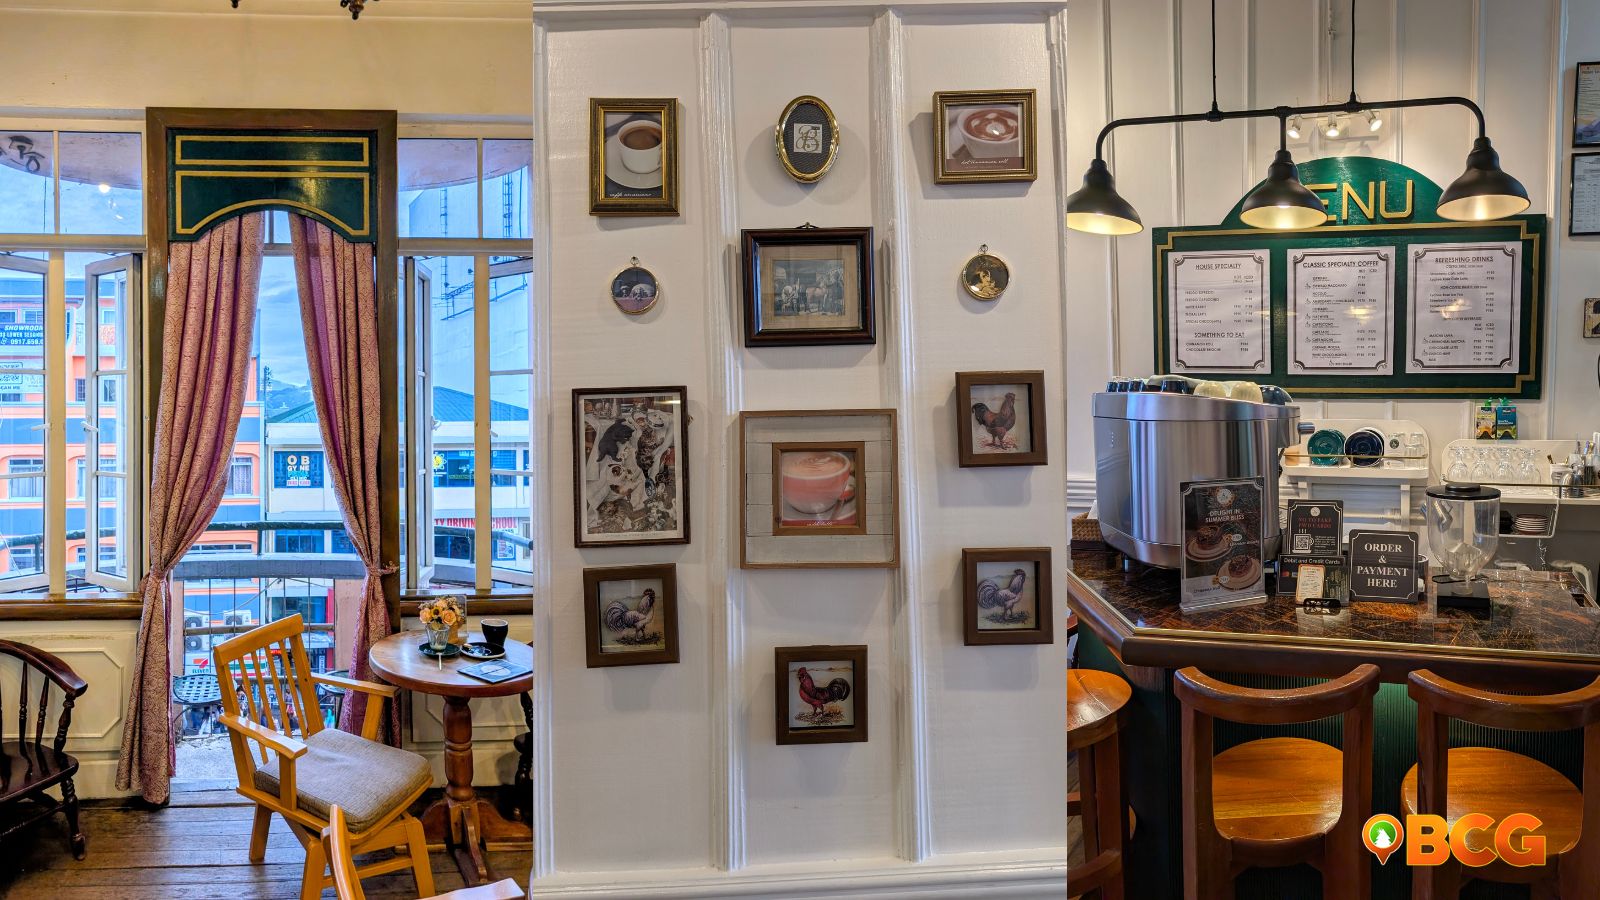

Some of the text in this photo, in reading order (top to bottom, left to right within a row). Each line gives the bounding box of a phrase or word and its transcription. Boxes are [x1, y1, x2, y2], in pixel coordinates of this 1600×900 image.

[1305, 180, 1413, 222] ENU
[447, 518, 476, 528] DRIVIN
[492, 517, 517, 528] CHOOL
[1364, 543, 1402, 553] ORDER
[1378, 555, 1387, 563] &
[1357, 566, 1408, 576] PAYMENT
[1367, 579, 1398, 588] HERE
